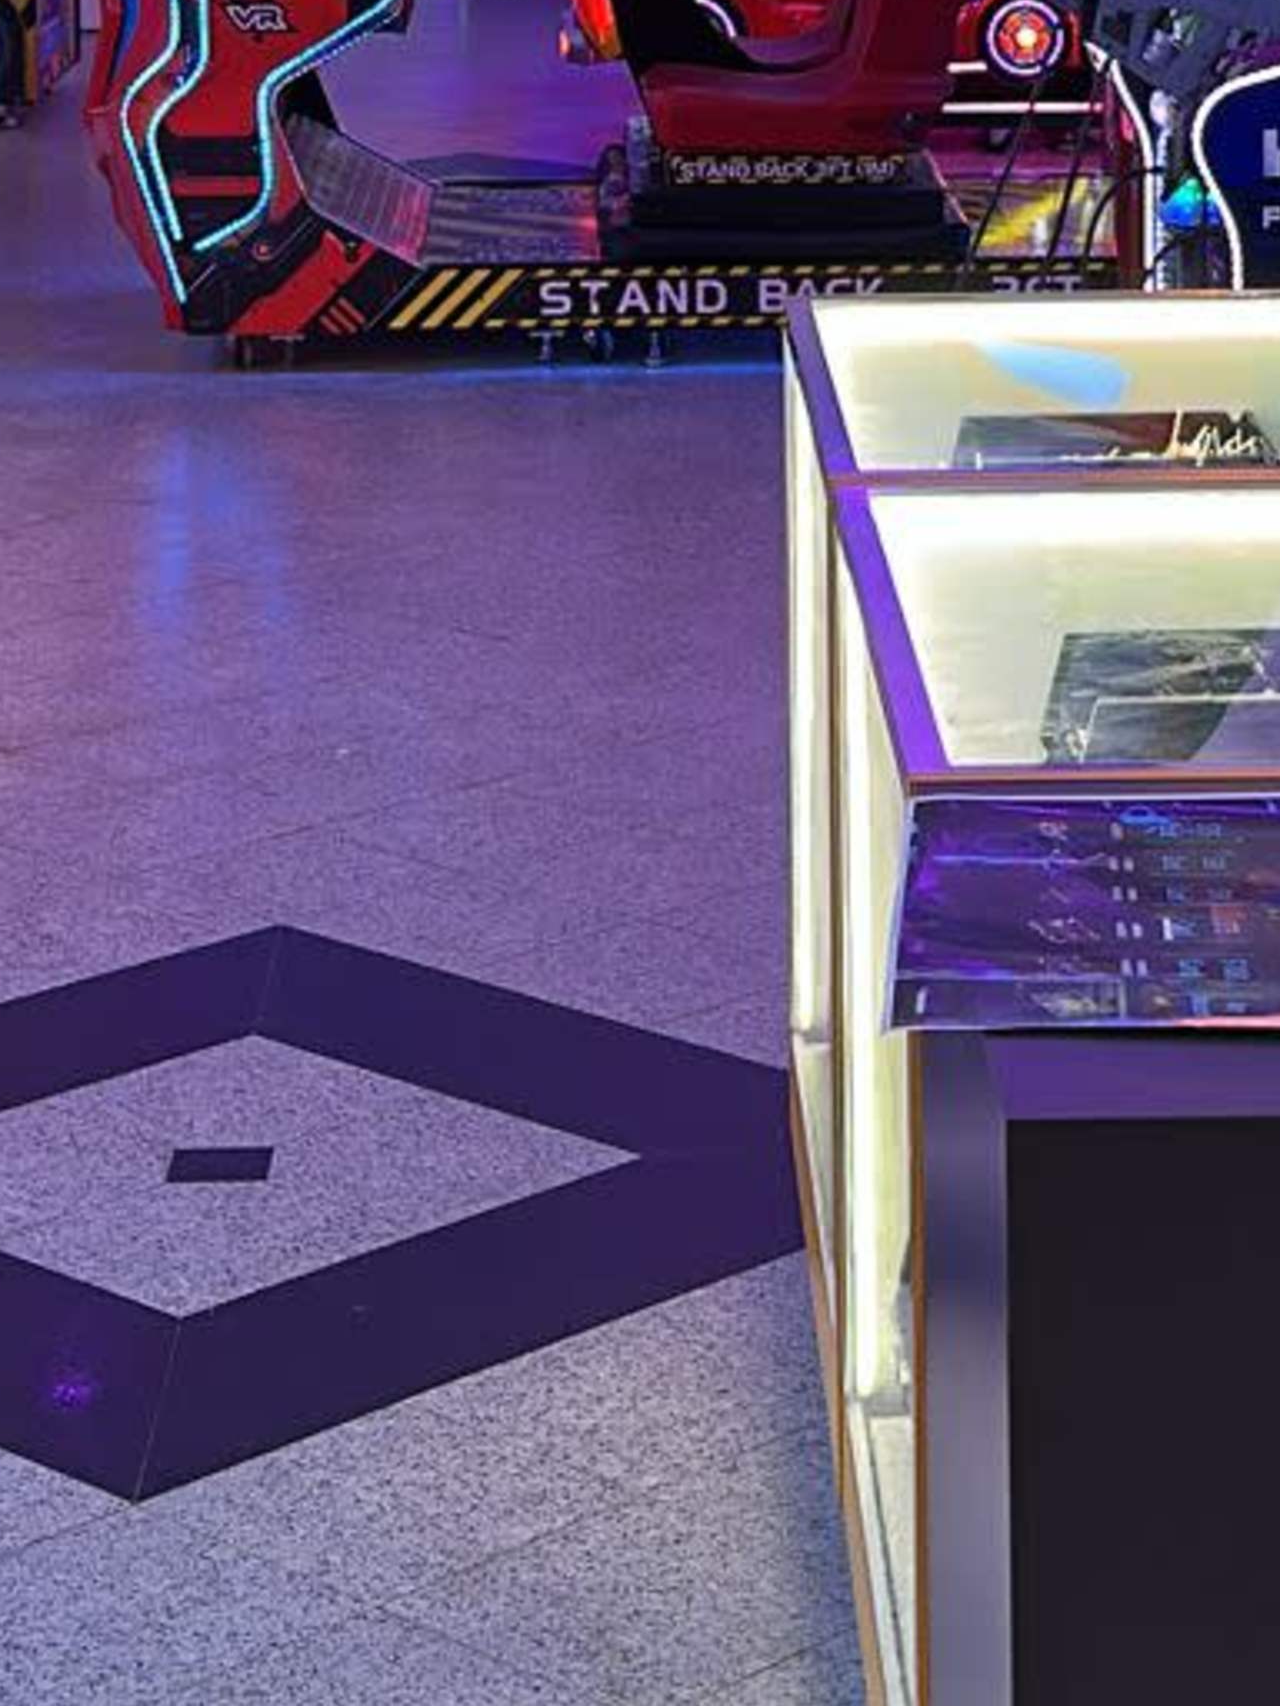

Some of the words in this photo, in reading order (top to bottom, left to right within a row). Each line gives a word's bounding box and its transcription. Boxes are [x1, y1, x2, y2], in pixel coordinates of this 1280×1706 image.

[225, 3, 288, 30] VR
[678, 161, 750, 179] STAND
[539, 278, 728, 316] STAND
